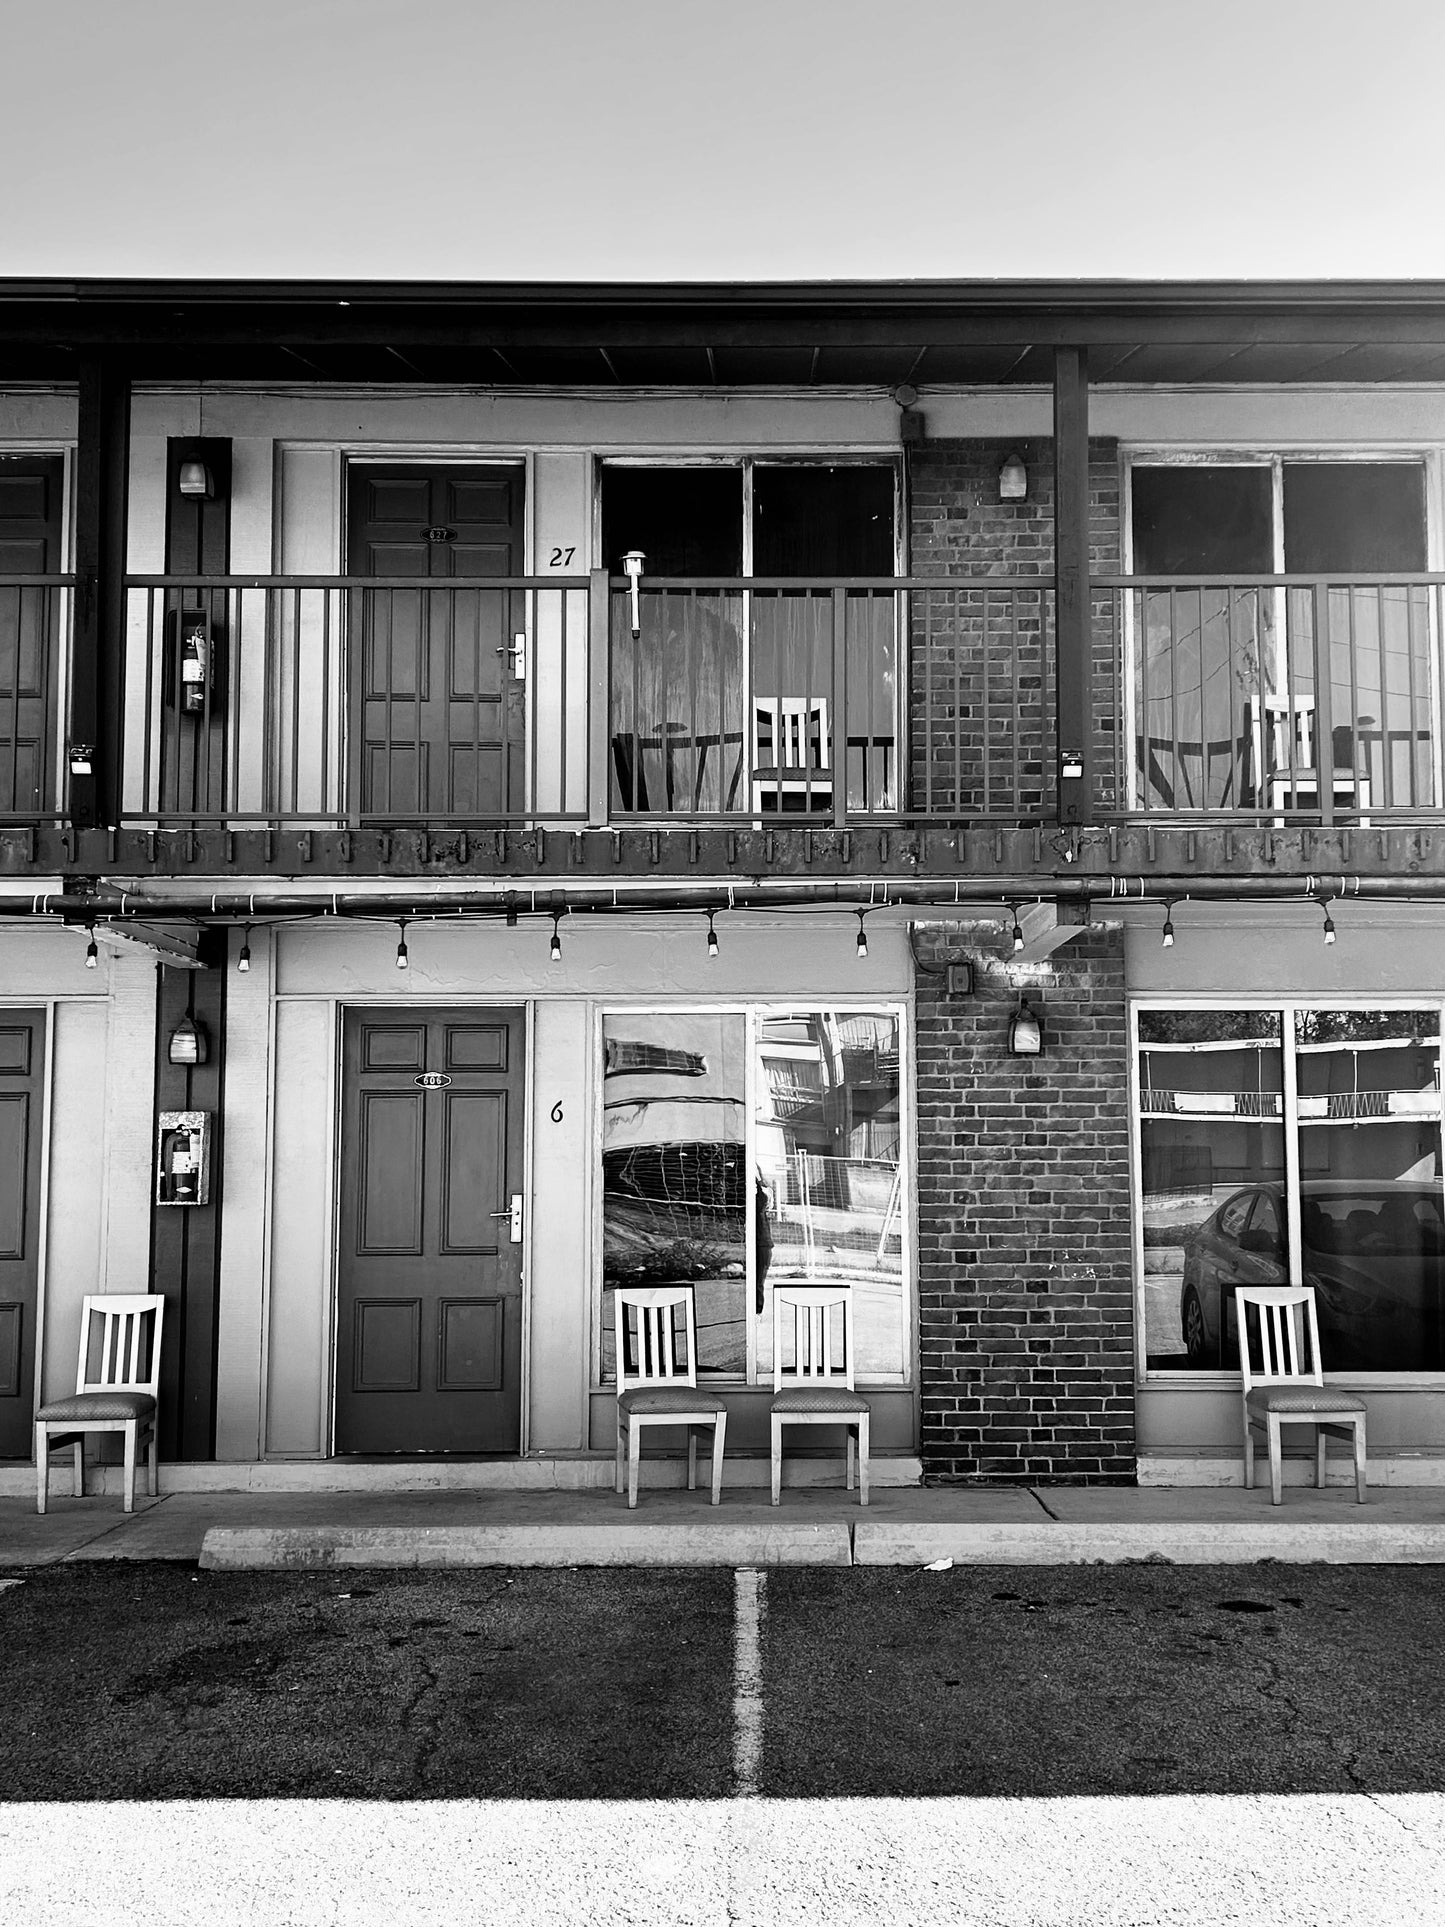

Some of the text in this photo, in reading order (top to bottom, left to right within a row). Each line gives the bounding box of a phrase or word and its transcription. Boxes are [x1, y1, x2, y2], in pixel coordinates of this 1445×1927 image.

[430, 531, 447, 539] 627
[550, 547, 576, 567] 27
[424, 1075, 441, 1085] 606
[551, 1100, 563, 1123] 6
